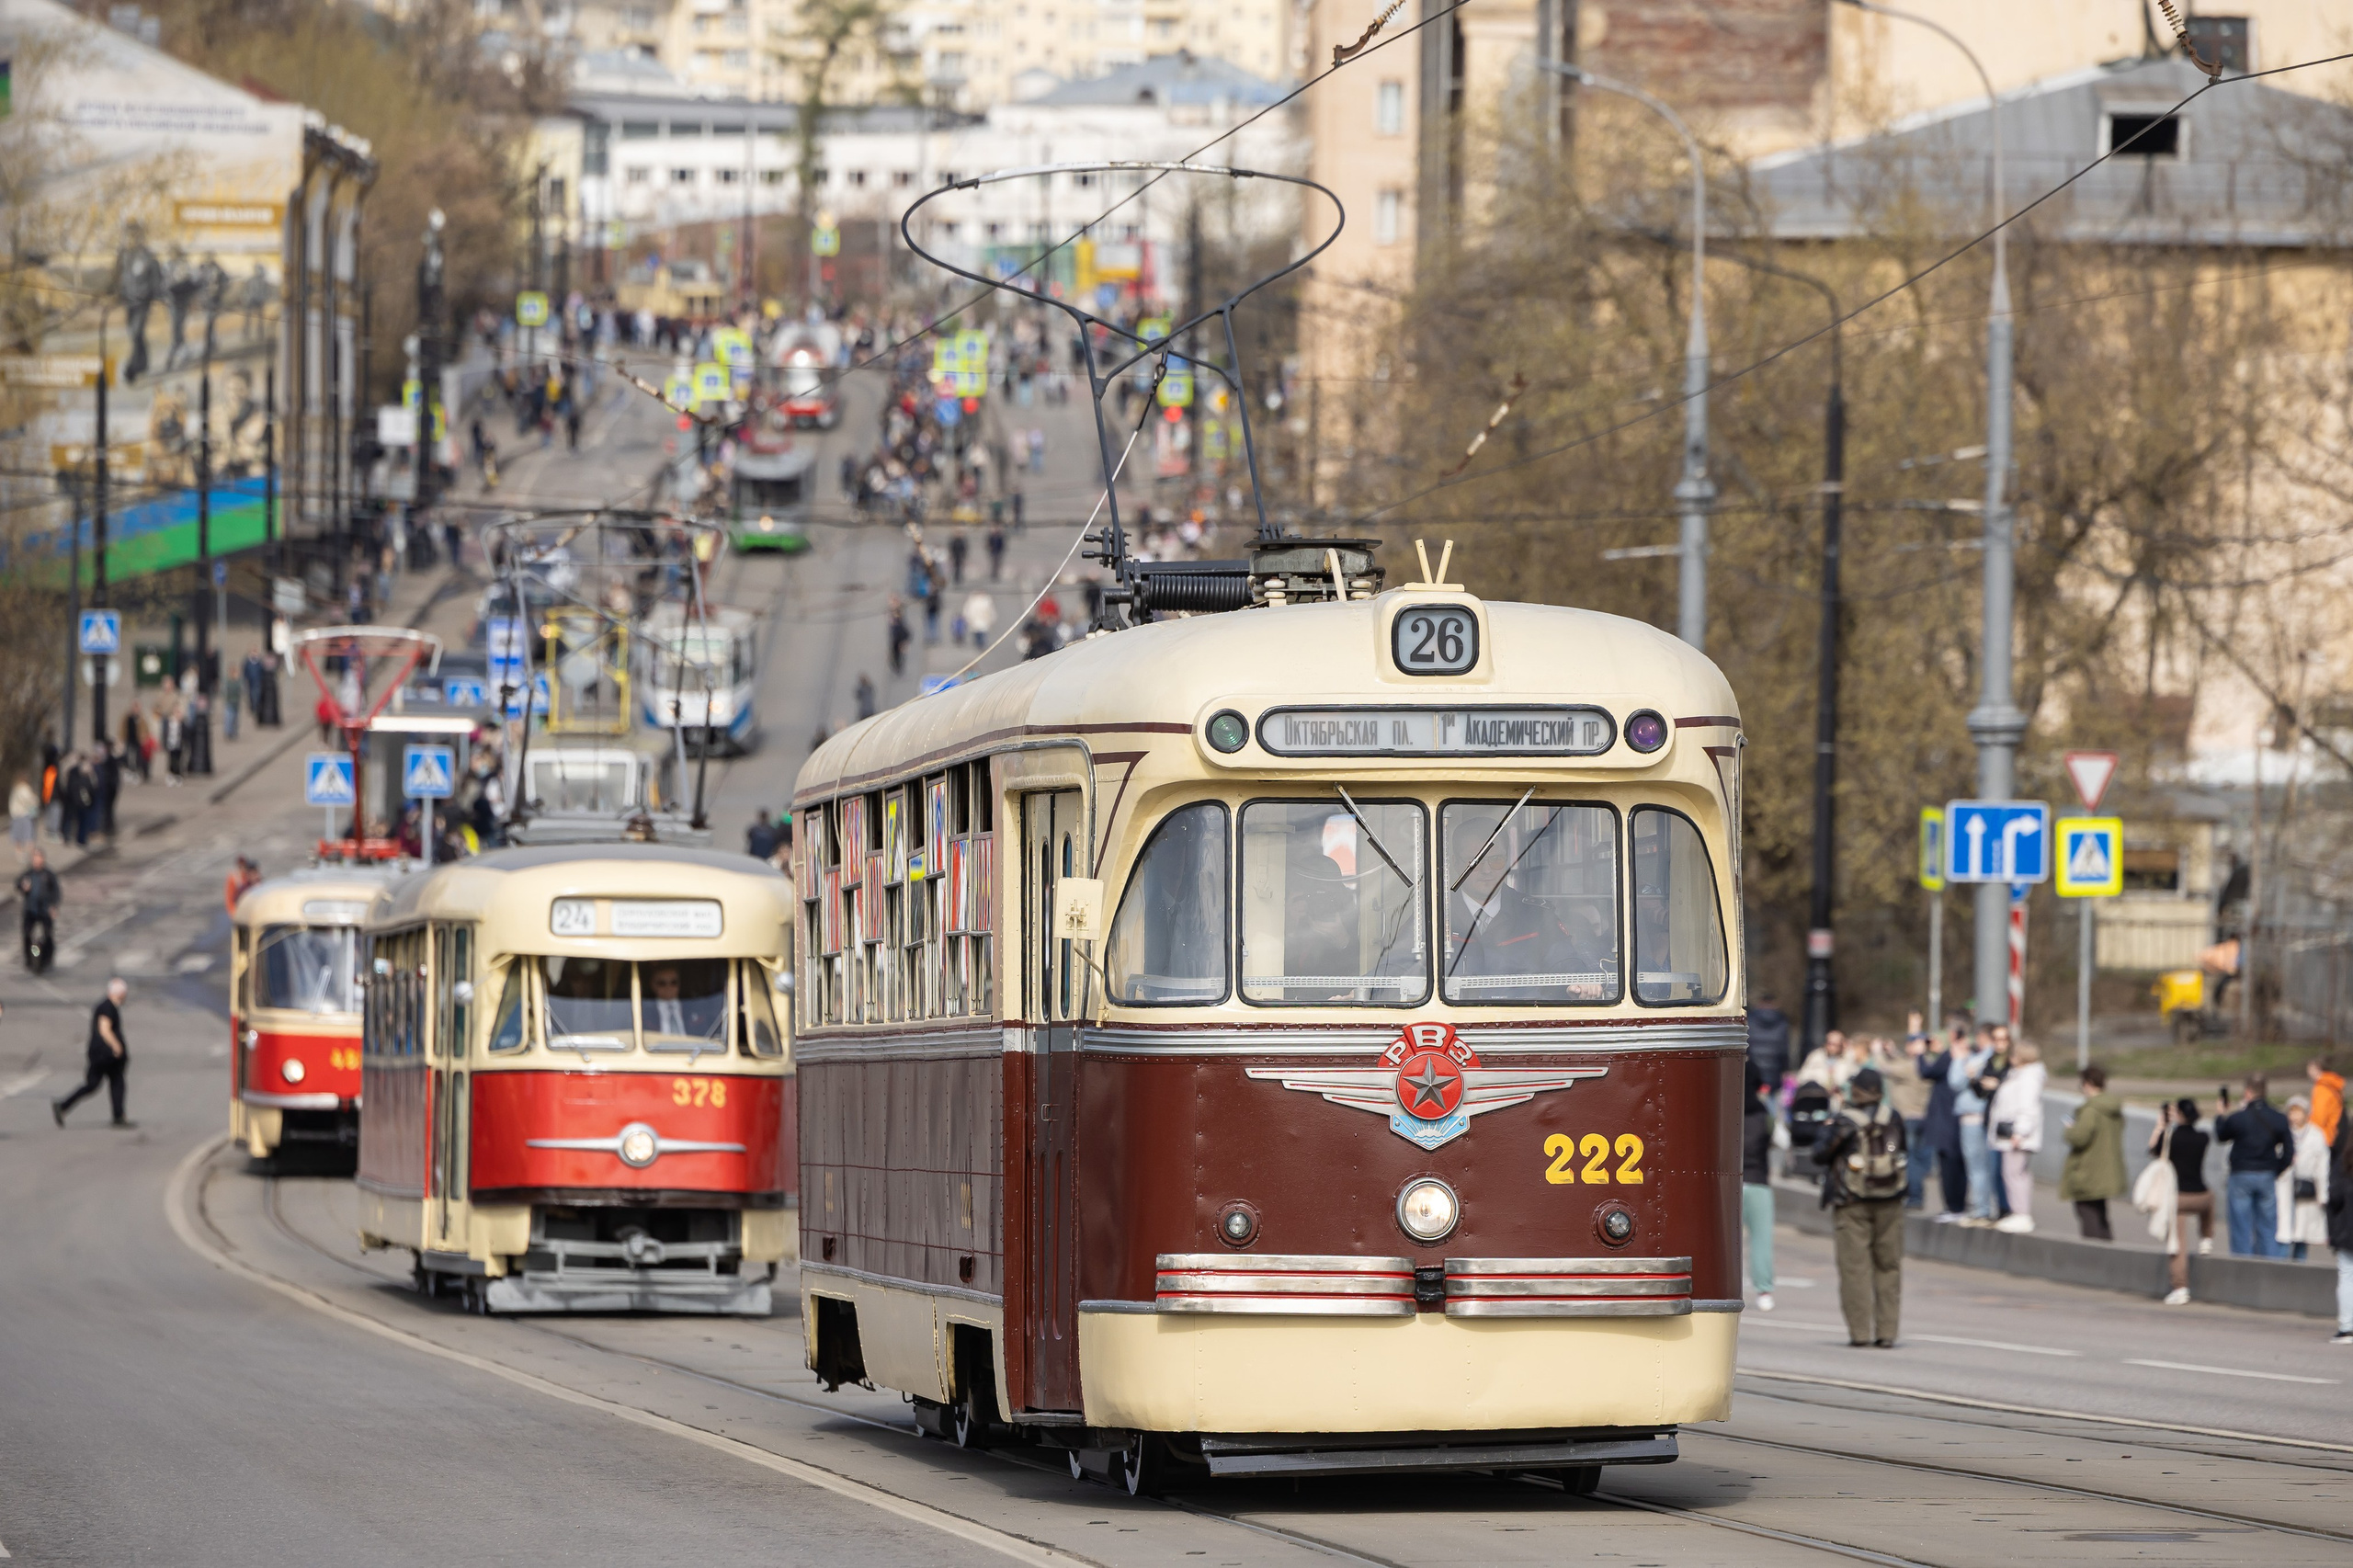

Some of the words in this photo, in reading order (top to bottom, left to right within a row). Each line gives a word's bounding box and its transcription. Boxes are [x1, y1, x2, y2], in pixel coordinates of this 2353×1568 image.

[1409, 617, 1464, 663] 26
[556, 903, 590, 930] 24
[1384, 1025, 1473, 1065] РВЗ
[672, 1077, 727, 1108] 378
[1543, 1132, 1644, 1185] 222
